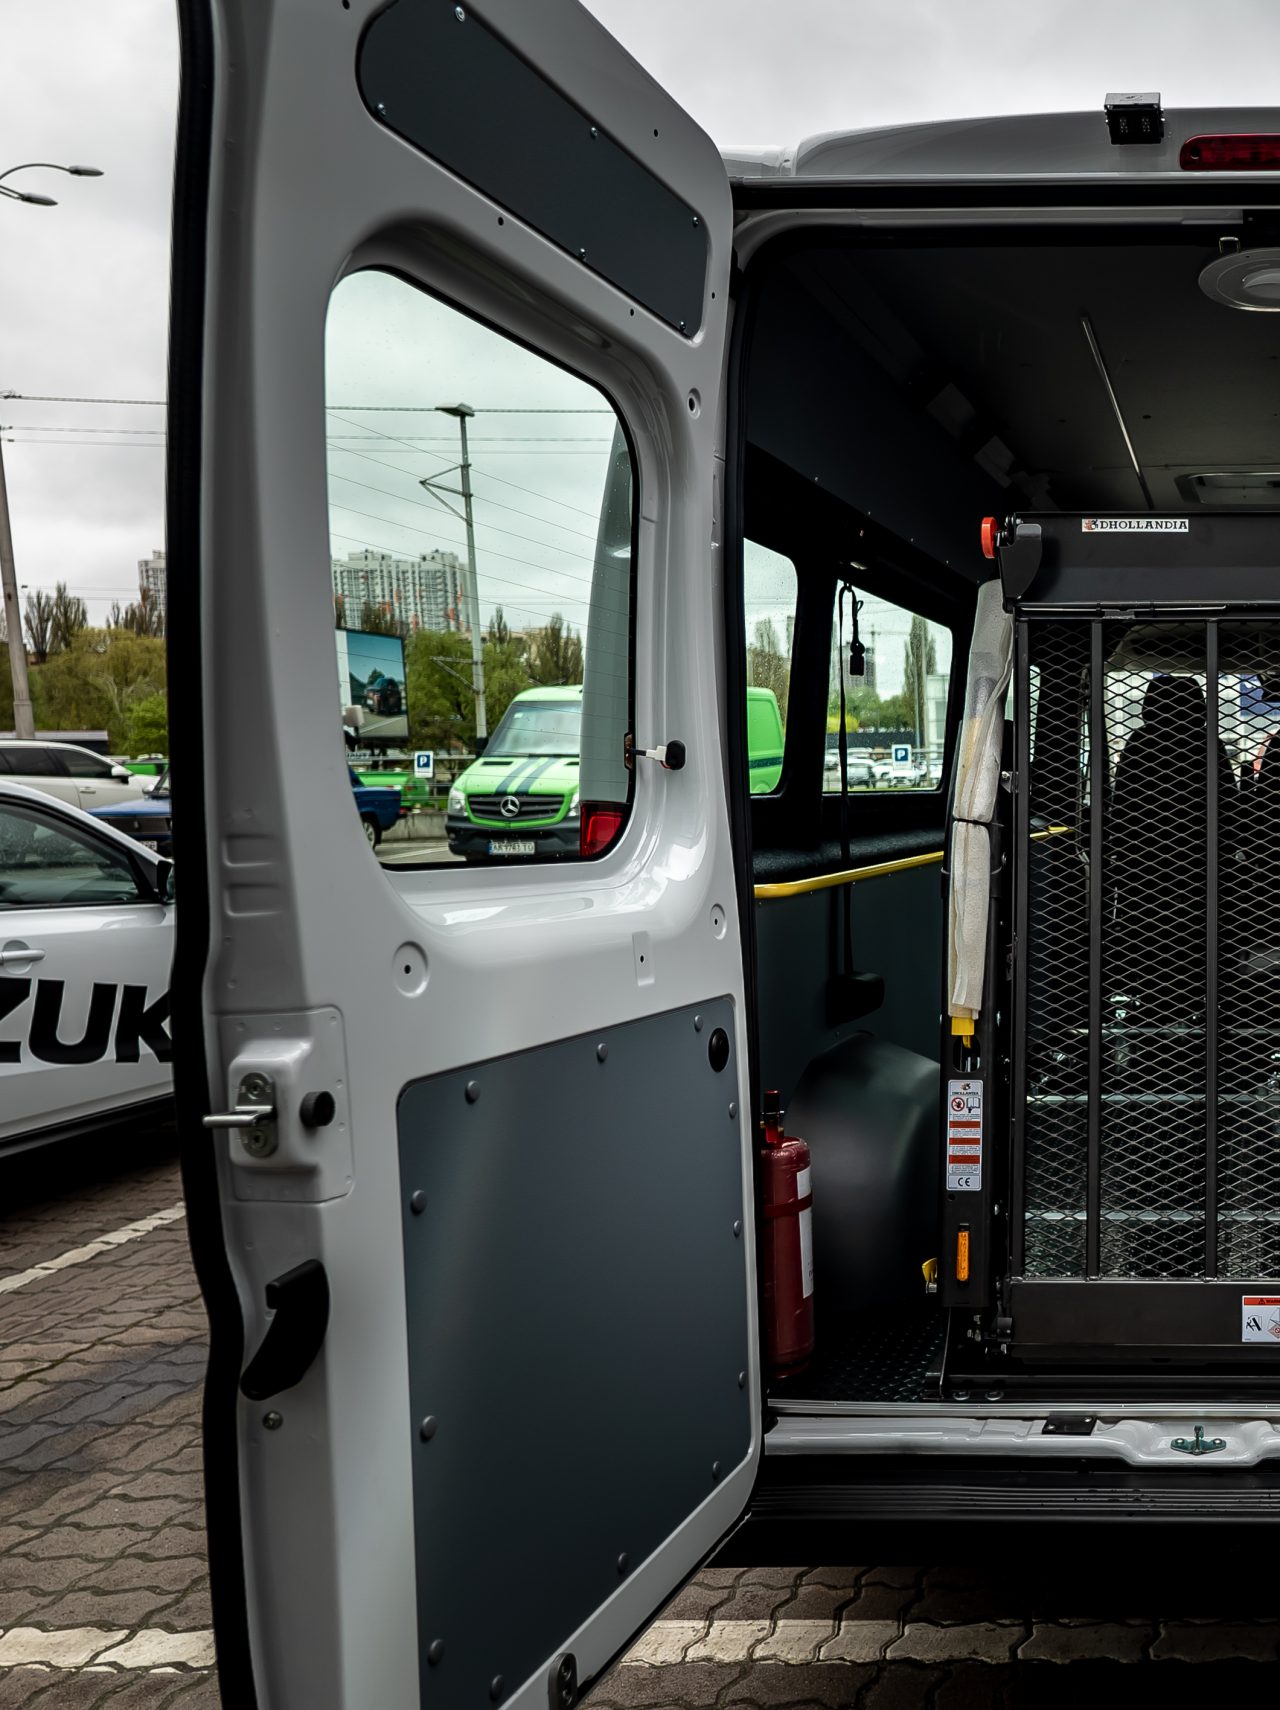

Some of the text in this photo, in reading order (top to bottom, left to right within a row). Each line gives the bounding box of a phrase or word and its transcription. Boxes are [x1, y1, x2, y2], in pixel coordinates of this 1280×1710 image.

[1100, 520, 1188, 530] DHOLLANDIA
[896, 749, 906, 760] P
[419, 755, 428, 766] P
